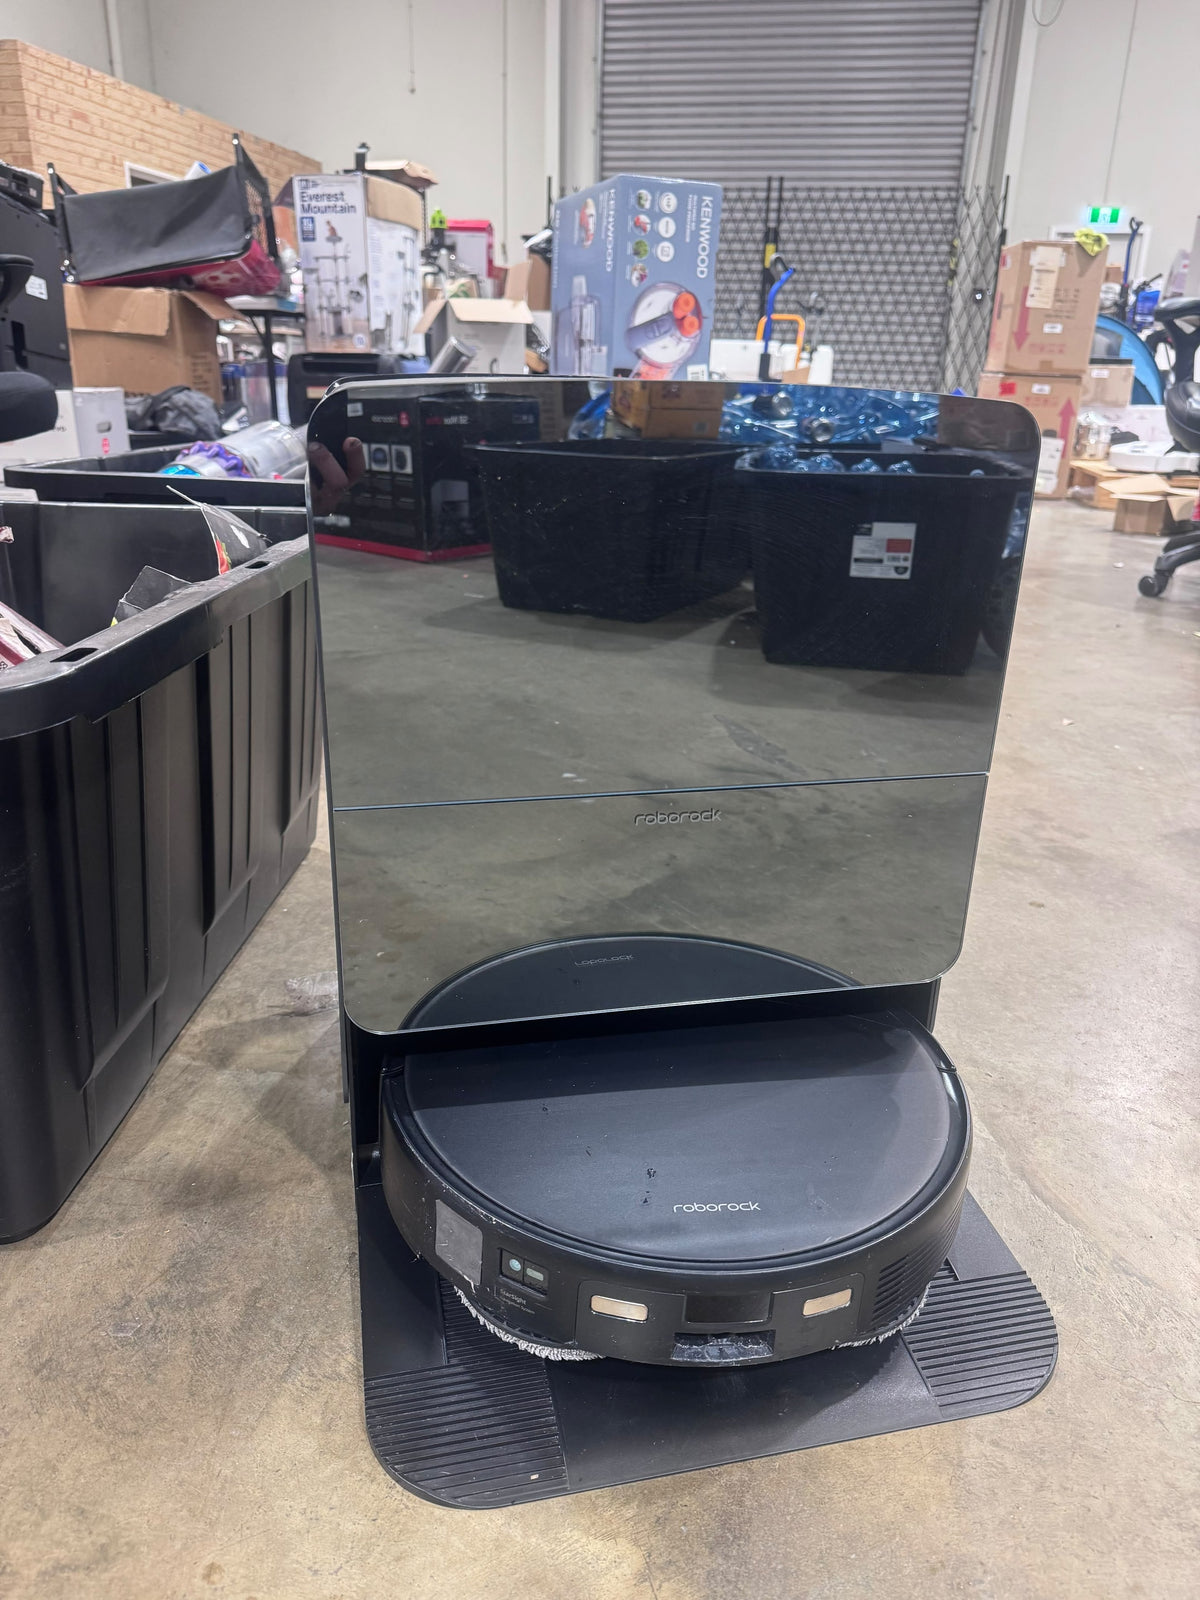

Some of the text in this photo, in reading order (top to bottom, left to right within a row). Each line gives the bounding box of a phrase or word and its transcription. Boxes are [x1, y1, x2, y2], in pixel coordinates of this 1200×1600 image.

[300, 191, 345, 202] Everest
[301, 203, 357, 214] Mountain
[605, 188, 616, 272] KENWOOD
[696, 196, 714, 278] KENWOOD
[634, 808, 722, 826] roborock
[673, 1200, 761, 1213] roborock
